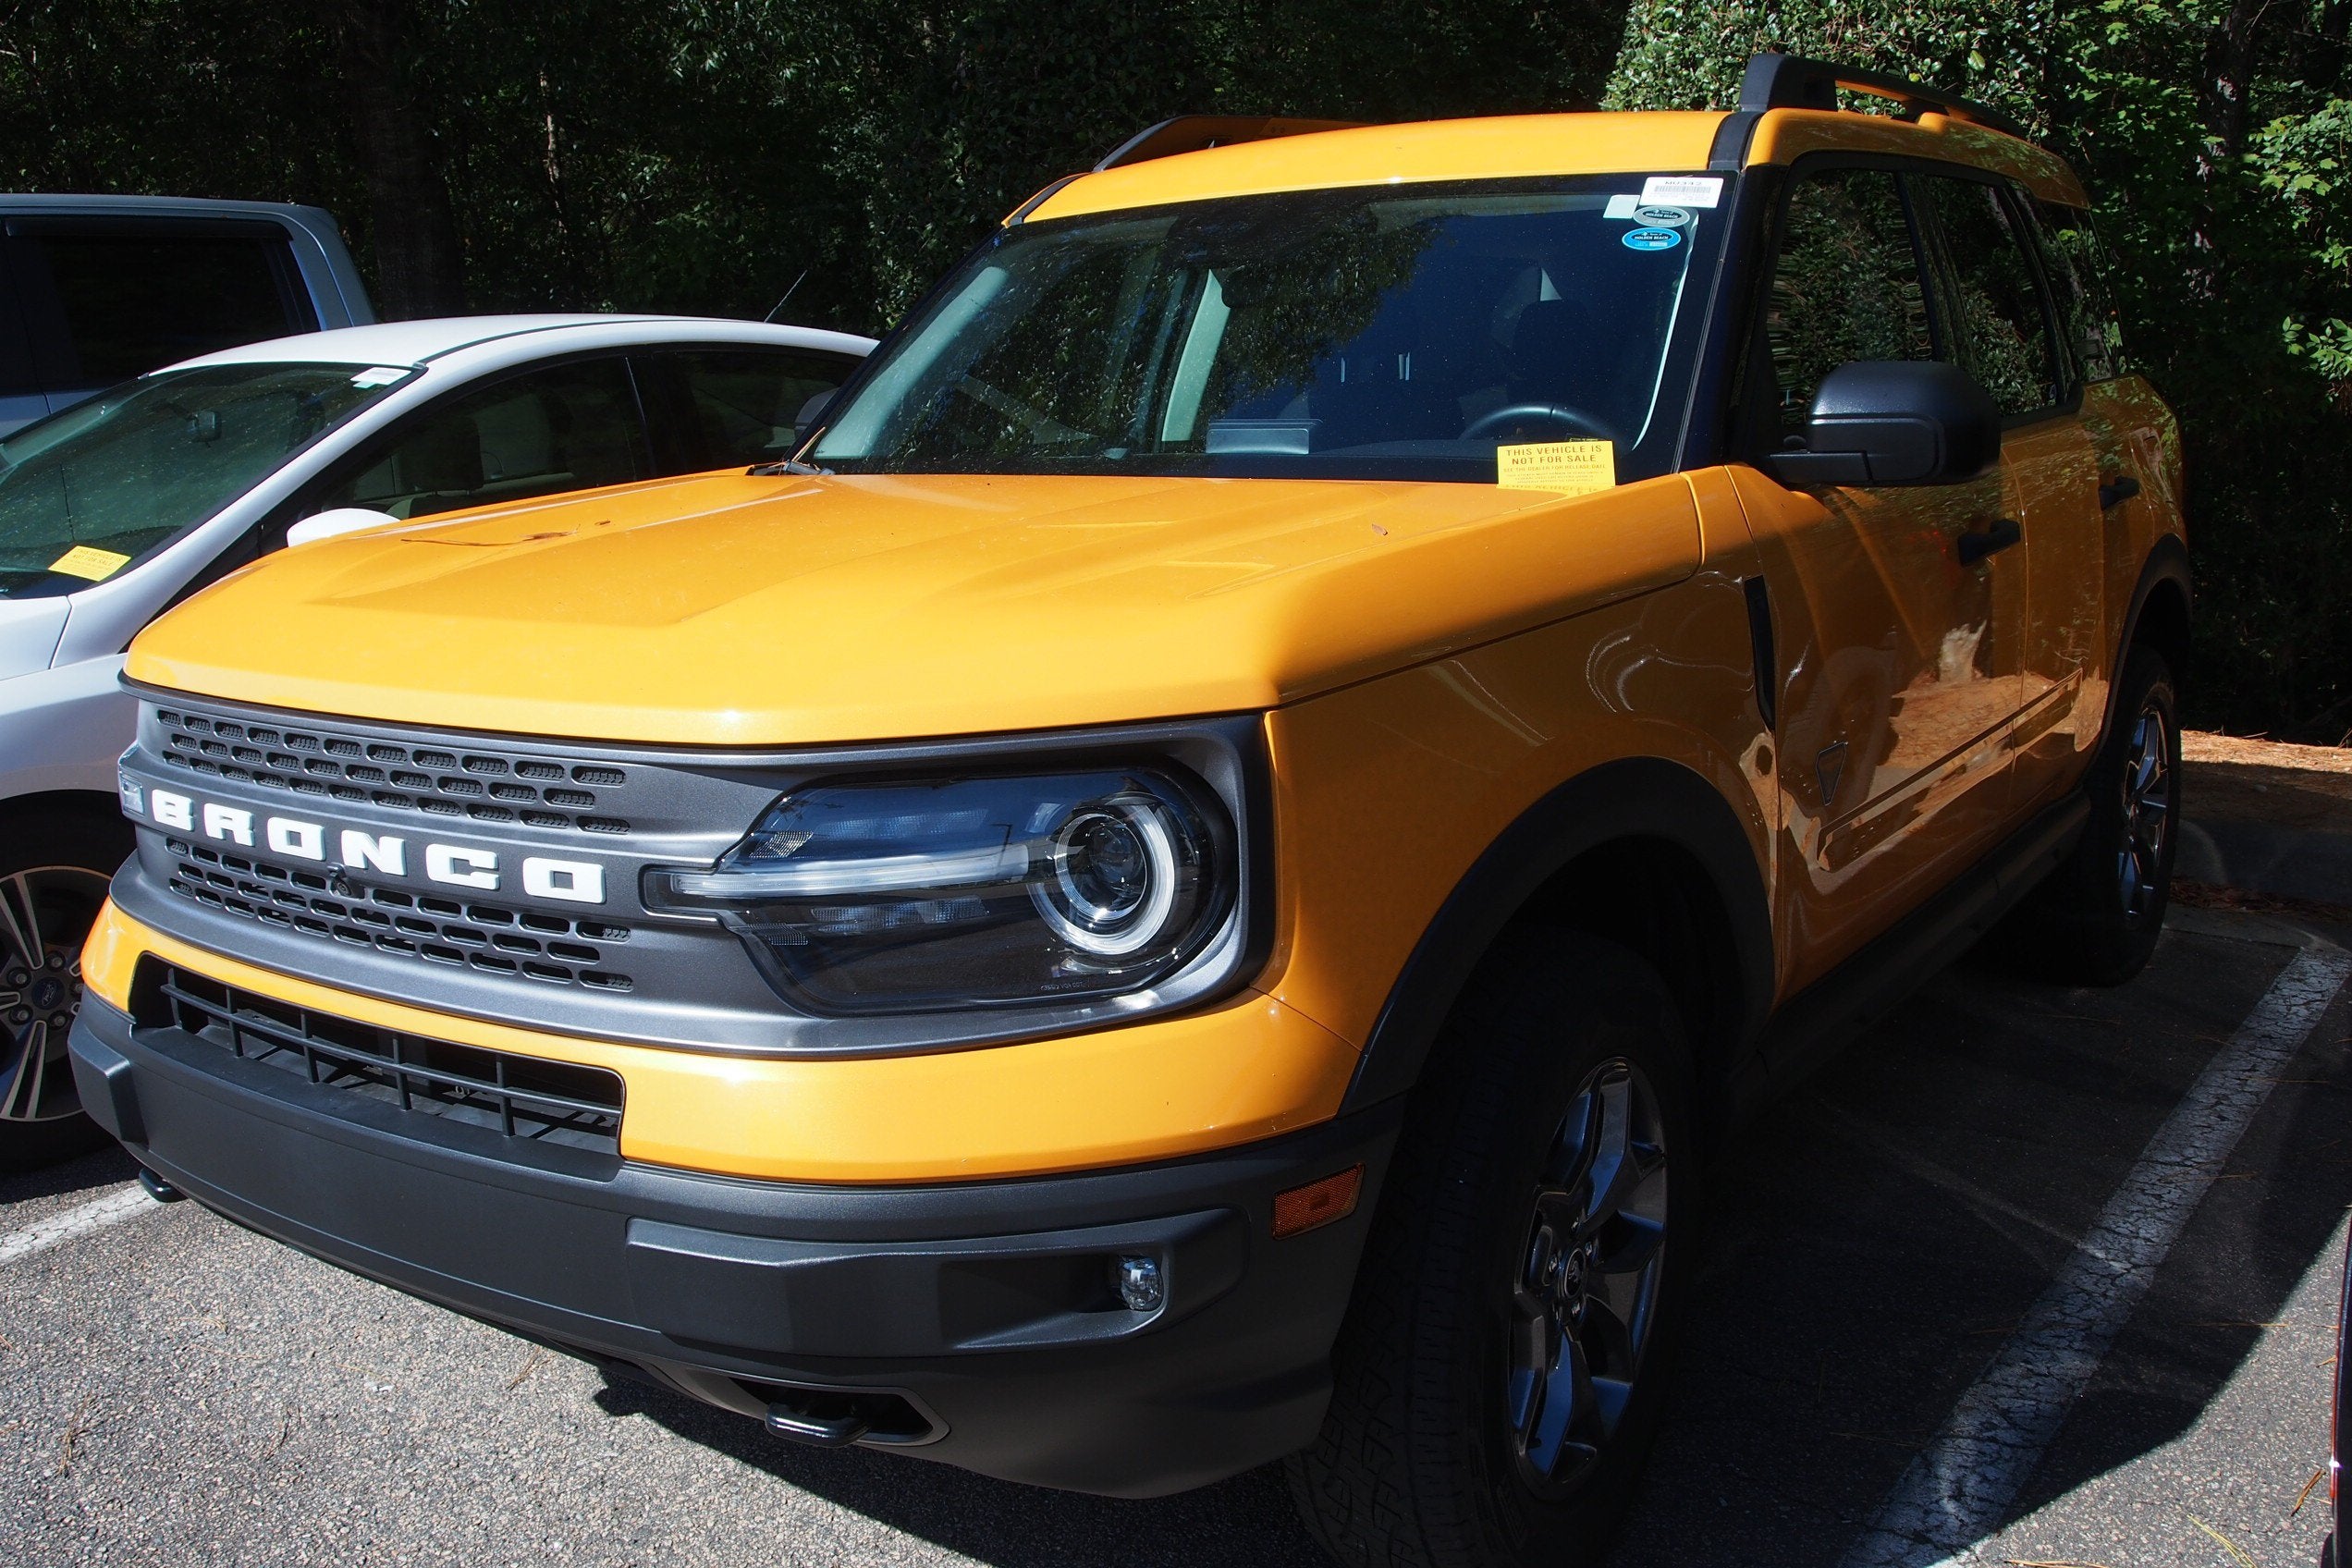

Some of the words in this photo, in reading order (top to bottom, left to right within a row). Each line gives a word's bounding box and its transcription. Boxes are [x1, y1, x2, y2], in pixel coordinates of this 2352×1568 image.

[1506, 448, 1532, 457] THIS
[1537, 446, 1586, 455] VEHICLE
[1591, 445, 1602, 453] IS
[1512, 457, 1534, 465] NOT
[1540, 455, 1562, 464] FOR
[1567, 454, 1597, 462] SALE
[151, 789, 606, 904] BRONCO
